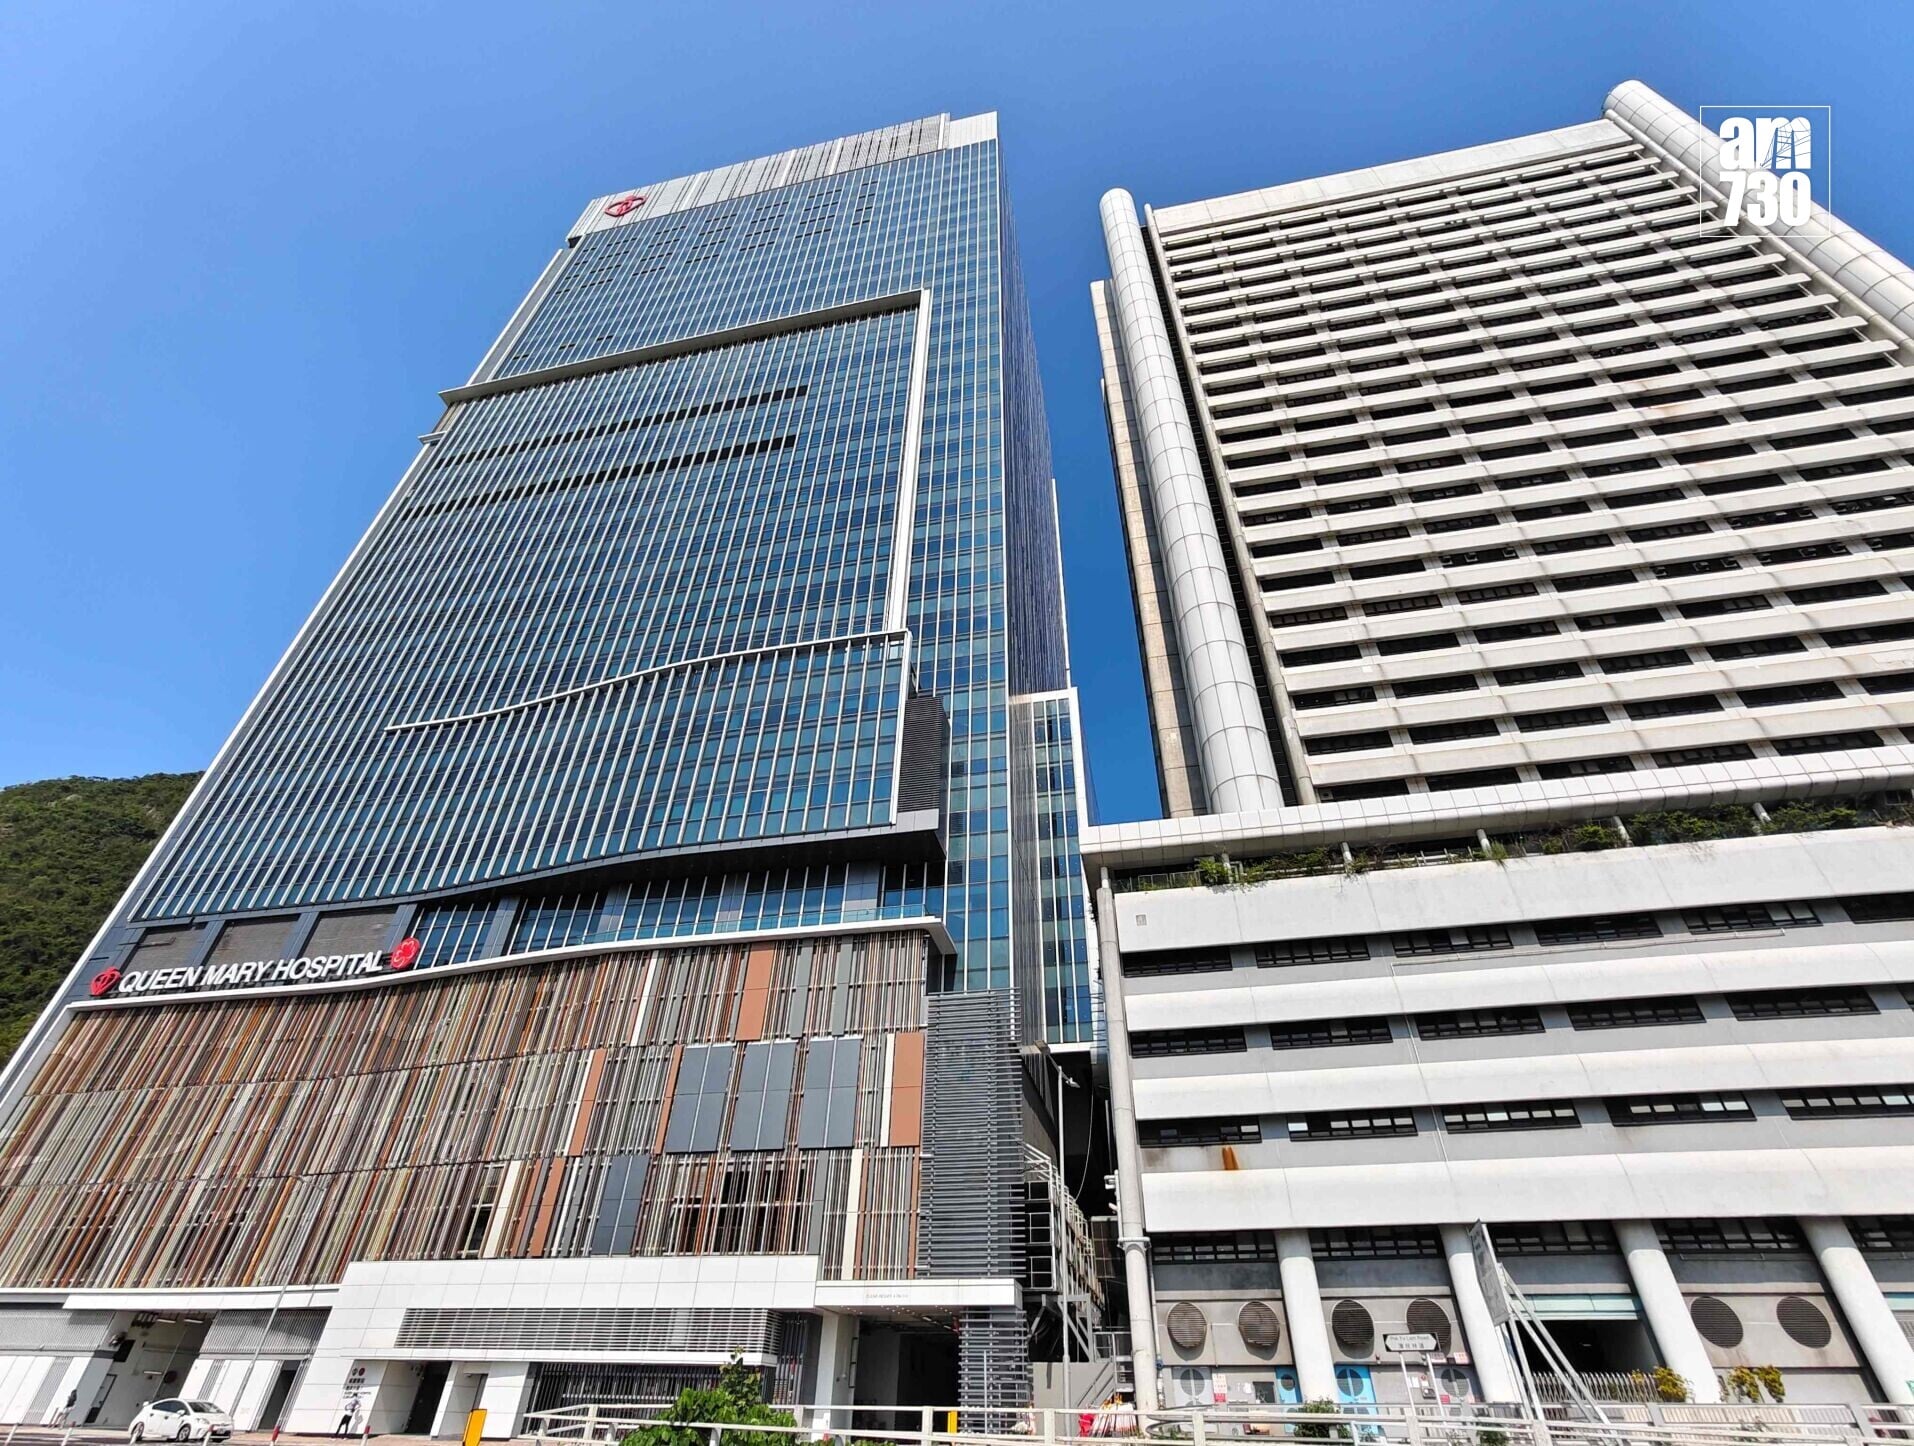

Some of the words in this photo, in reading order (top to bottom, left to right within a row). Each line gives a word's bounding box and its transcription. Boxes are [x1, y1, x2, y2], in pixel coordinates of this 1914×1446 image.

[118, 966, 203, 993] QUEEN
[200, 960, 274, 986] MARY
[271, 950, 383, 980] HOSPITAL
